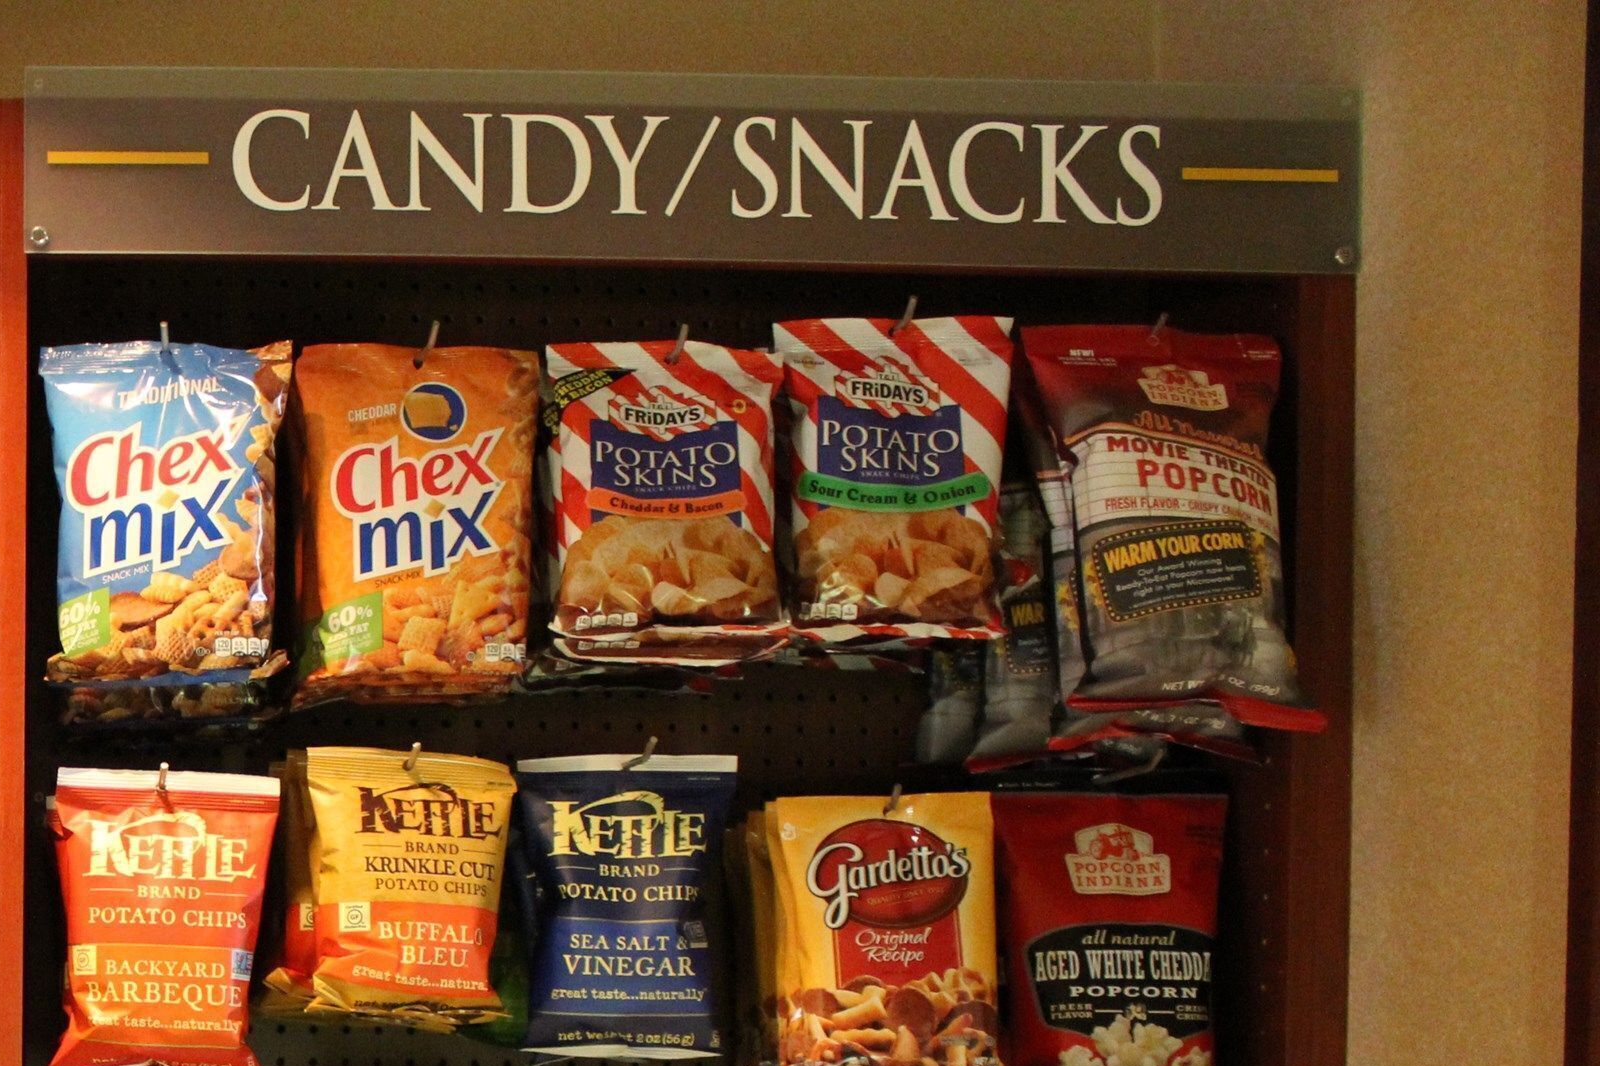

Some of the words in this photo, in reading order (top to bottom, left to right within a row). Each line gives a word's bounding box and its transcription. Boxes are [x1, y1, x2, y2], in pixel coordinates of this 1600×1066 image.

[232, 107, 1164, 227] CANDY/SNACKS
[348, 403, 397, 423] CHEDDAR
[821, 419, 960, 454] POTATO
[70, 413, 249, 507] Chex
[595, 440, 736, 469] POTATO
[840, 448, 941, 478] SKINS
[1107, 436, 1190, 461] MOVIE
[1200, 450, 1269, 490] THEATER
[335, 435, 495, 514] Chex
[614, 464, 717, 488] SKINS
[808, 479, 843, 498] Sour
[846, 487, 898, 505] Cream
[904, 491, 917, 505] &
[923, 484, 976, 504] Onion
[1136, 459, 1273, 517] POPCORN
[610, 497, 665, 514] Cheddar
[668, 502, 680, 514] &
[685, 500, 723, 514] Bacon
[1105, 499, 1137, 512] FRESH
[1140, 498, 1180, 511] FLAVOR
[90, 479, 232, 570] mix
[359, 490, 495, 575] mix
[1104, 542, 1157, 574] WARM
[1157, 534, 1201, 559] YOUR
[1201, 531, 1245, 551] CORN
[102, 570, 131, 585] SNACK
[375, 574, 404, 589] SNACK
[328, 605, 373, 633] 60%
[354, 783, 503, 841] KETTLE
[546, 790, 707, 859] KETTLE
[82, 811, 255, 882] KETTLE
[405, 841, 459, 855] BRAND
[365, 857, 456, 877] KRINKLE
[459, 861, 496, 882] CUT
[600, 864, 660, 878] BRAND
[137, 885, 200, 900] BRAND
[376, 878, 439, 893] POTATO
[444, 881, 487, 898] CHIPS
[558, 883, 637, 903] POTATO
[806, 842, 971, 929] Gardetto's
[1075, 875, 1165, 889] INDIANA
[88, 906, 176, 925] POTATO
[183, 910, 247, 929] CHIPS
[570, 934, 609, 950] SEA
[616, 935, 671, 950] SALT
[676, 937, 689, 950] &
[856, 927, 932, 951] Original
[1082, 930, 1108, 946] all
[1111, 930, 1176, 946] natural
[401, 946, 468, 968] BLEU
[563, 954, 696, 977] VINEGAR
[862, 946, 925, 966] Recipe
[1035, 951, 1080, 982] AGED
[1086, 949, 1145, 980] WHITE
[105, 960, 225, 979] BACKYARD
[352, 964, 391, 982] great
[85, 981, 242, 1011] BARBEQUE
[551, 987, 588, 1000] great
[1070, 985, 1198, 999] POPCORN
[558, 1031, 580, 1042] net
